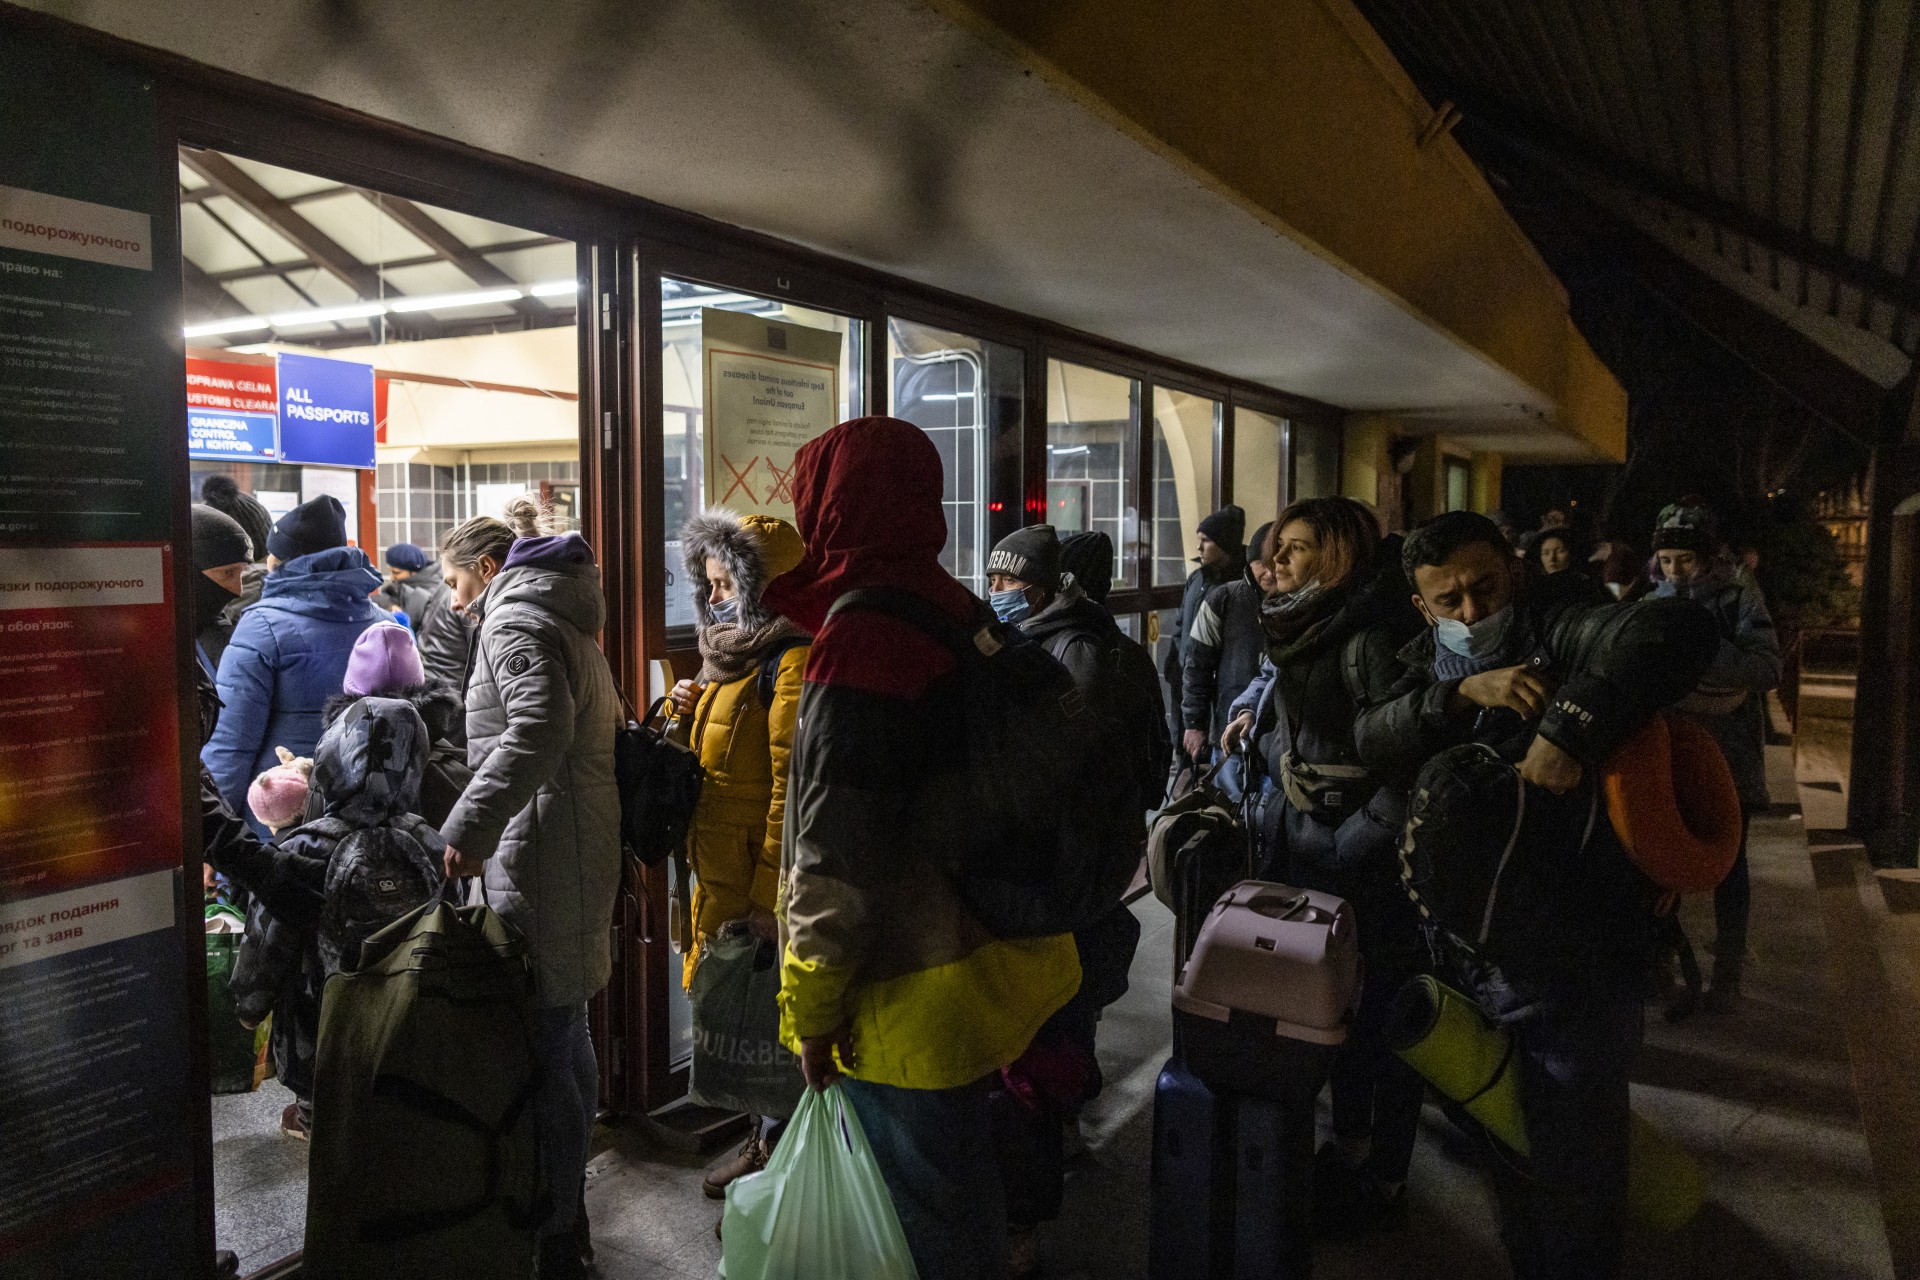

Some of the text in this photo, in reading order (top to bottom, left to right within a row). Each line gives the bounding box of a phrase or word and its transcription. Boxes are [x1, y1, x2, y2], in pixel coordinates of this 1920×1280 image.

[2, 218, 141, 252] подорожуючого
[236, 380, 272, 395] CELNA
[285, 387, 313, 404] ALL
[187, 392, 232, 408] USTOMS
[286, 404, 370, 425] PASSPORTS
[191, 428, 237, 440] CONTROL
[35, 579, 144, 593] подорожуючого
[50, 898, 120, 924] подання
[45, 926, 84, 945] заяв
[693, 1026, 797, 1067] PULL&BE
